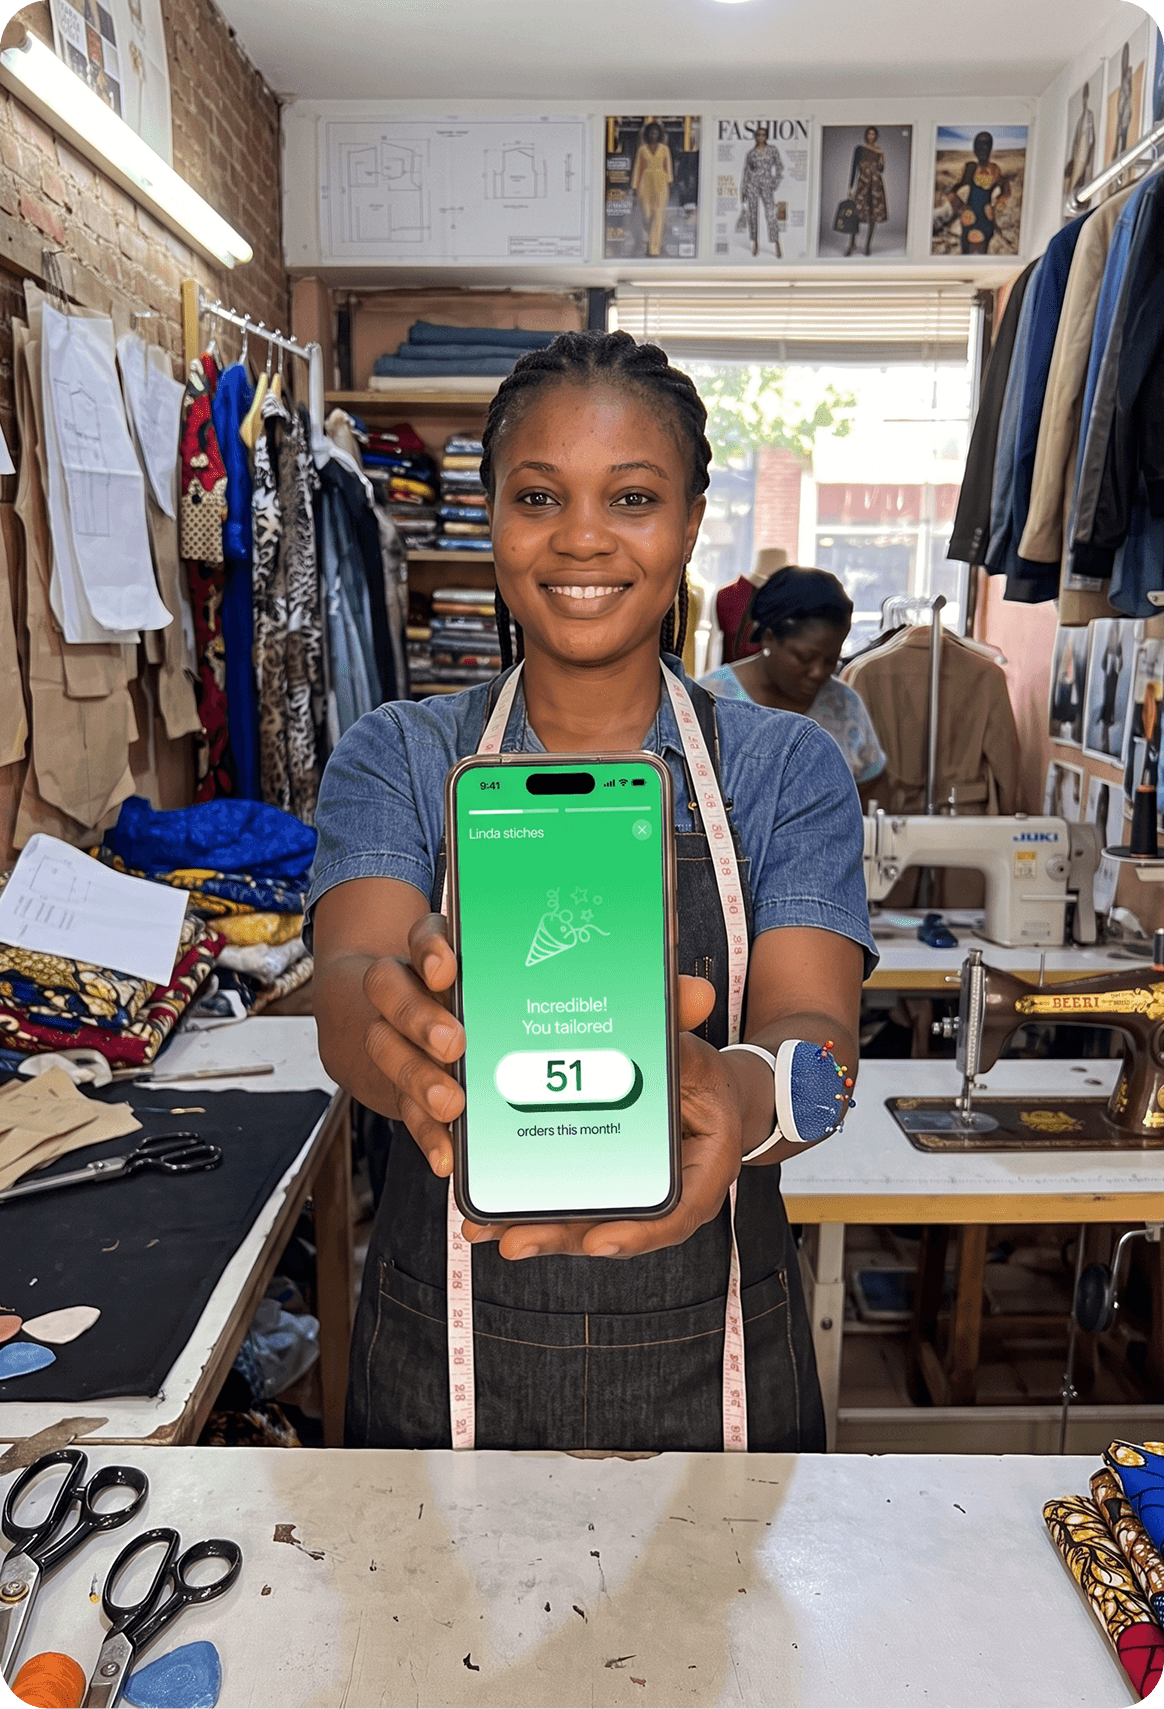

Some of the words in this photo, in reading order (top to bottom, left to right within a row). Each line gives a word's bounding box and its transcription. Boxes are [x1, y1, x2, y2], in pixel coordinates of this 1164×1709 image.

[717, 119, 809, 141] FASHION
[479, 781, 501, 791] 9:41
[469, 828, 501, 840] Linda
[503, 827, 545, 839] stiches
[1013, 832, 1059, 842] JUKI
[526, 996, 608, 1014] Incredible!
[1053, 997, 1100, 1009] BEERI
[522, 1019, 551, 1035] You
[555, 1017, 613, 1035] tailored
[546, 1060, 582, 1092] 51
[516, 1125, 555, 1138] orders
[557, 1123, 578, 1136] this
[579, 1122, 621, 1136] month!
